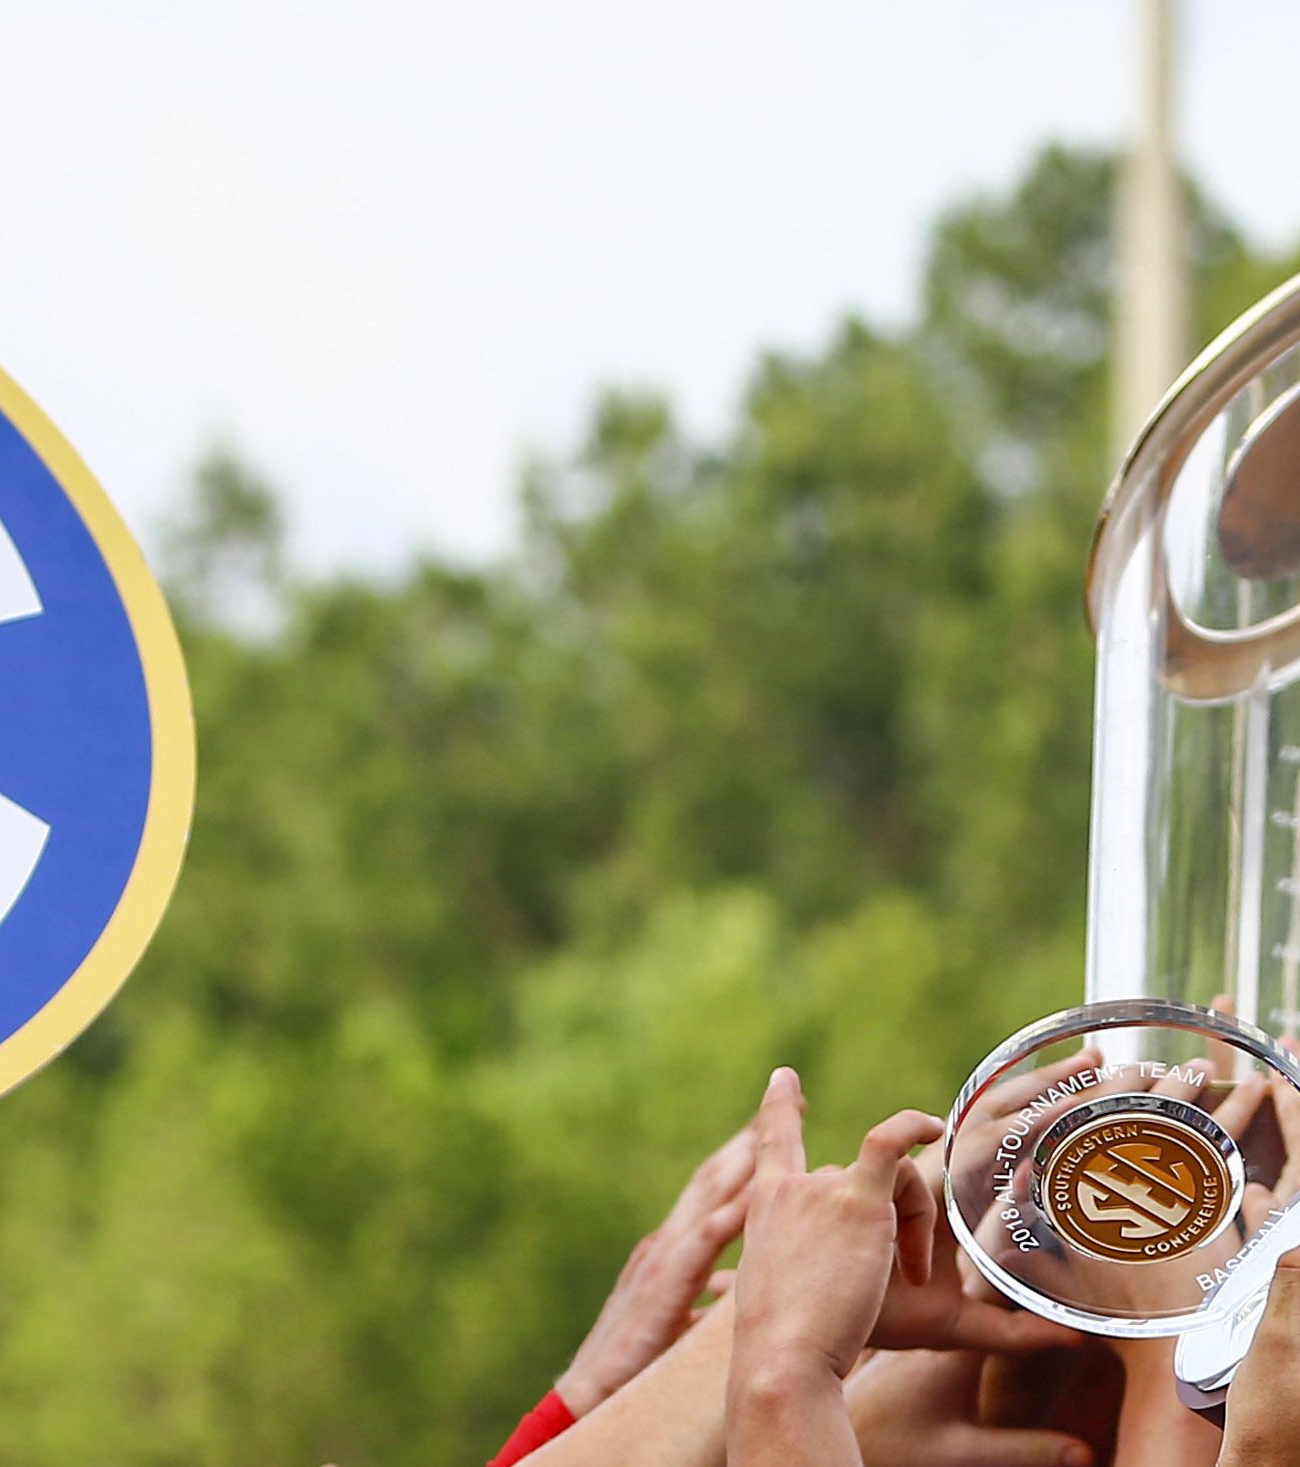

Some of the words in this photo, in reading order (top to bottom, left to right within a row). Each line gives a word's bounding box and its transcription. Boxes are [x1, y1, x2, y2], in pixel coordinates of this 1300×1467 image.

[1001, 1208, 1040, 1252] 2018
[1136, 1062, 1206, 1087] TEAM
[1055, 1124, 1139, 1211] SOUTHEASTERN
[1077, 1143, 1196, 1238] SEC
[1145, 1176, 1218, 1256] CONFERENCE
